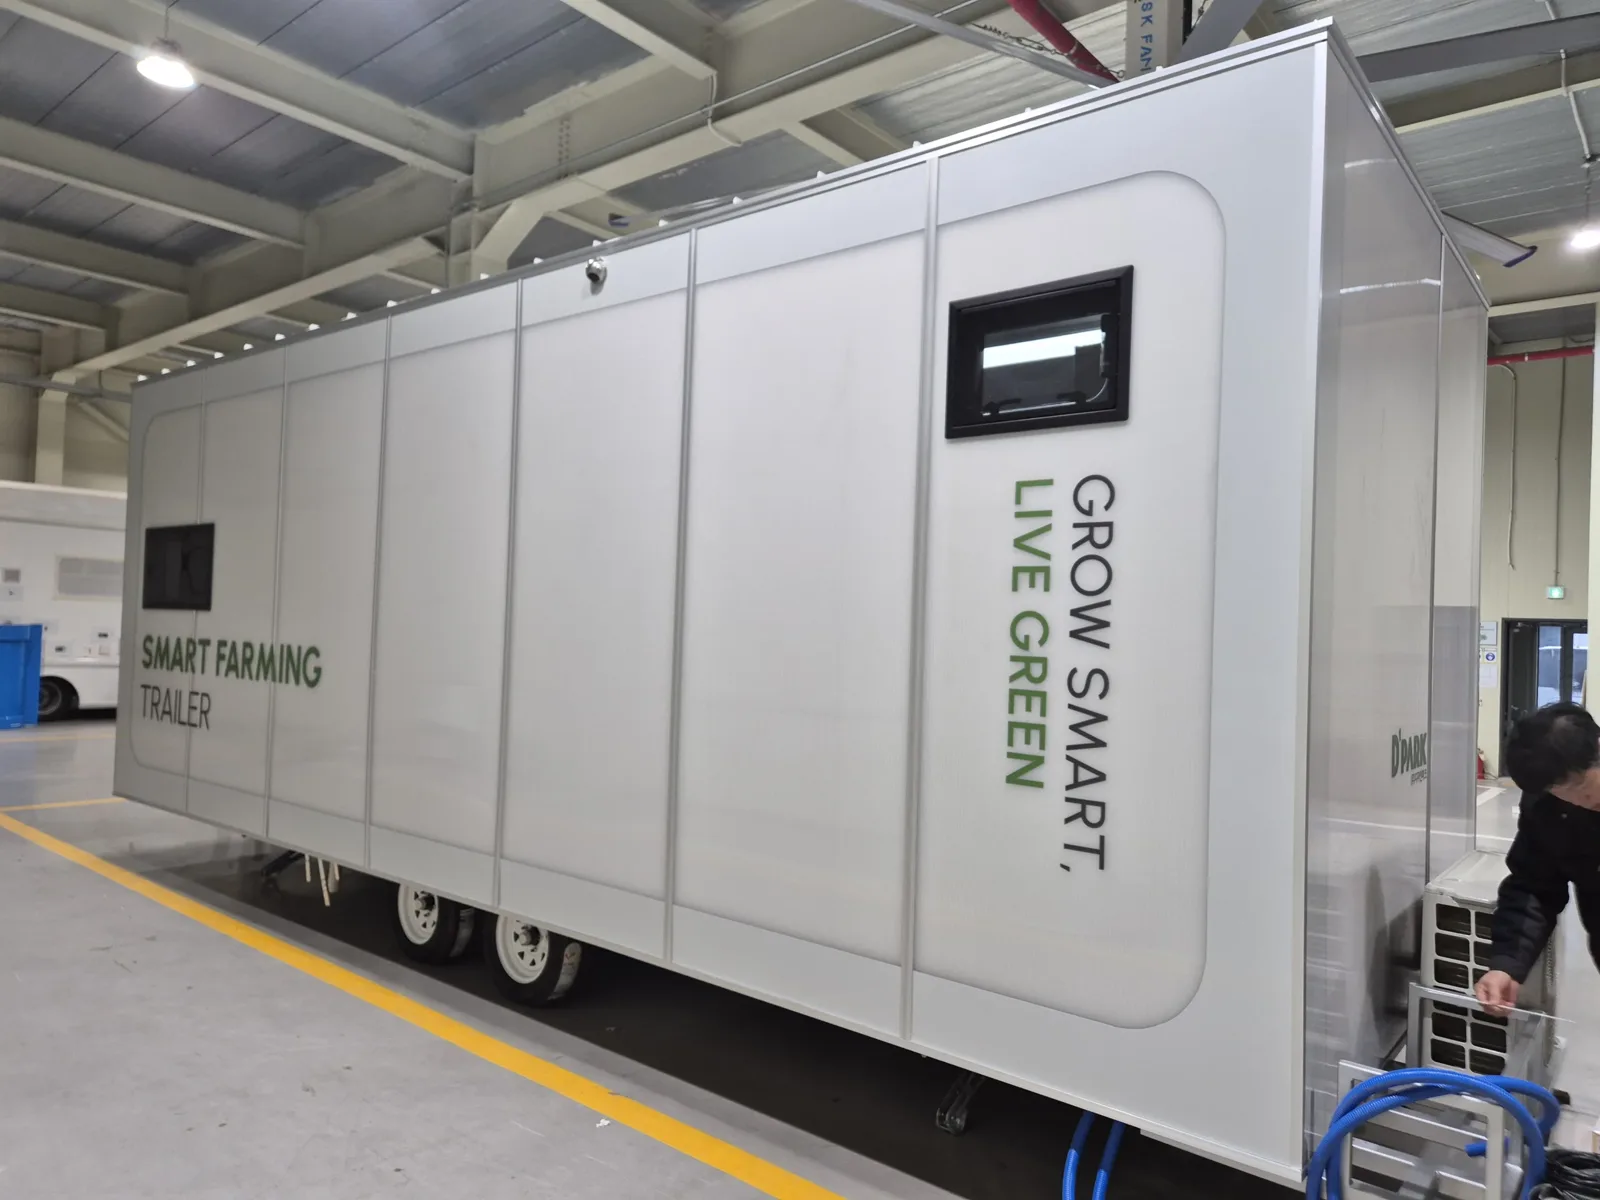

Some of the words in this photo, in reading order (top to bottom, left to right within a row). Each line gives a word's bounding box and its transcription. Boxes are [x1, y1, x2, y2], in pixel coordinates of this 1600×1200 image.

[1011, 478, 1054, 593] LIVE
[1069, 474, 1116, 650] GROW
[140, 684, 211, 731] TRAILER
[142, 634, 211, 675] SMART
[215, 639, 322, 688] FARMING
[1005, 610, 1050, 789] GREEN
[1060, 667, 1110, 872] SMART,
